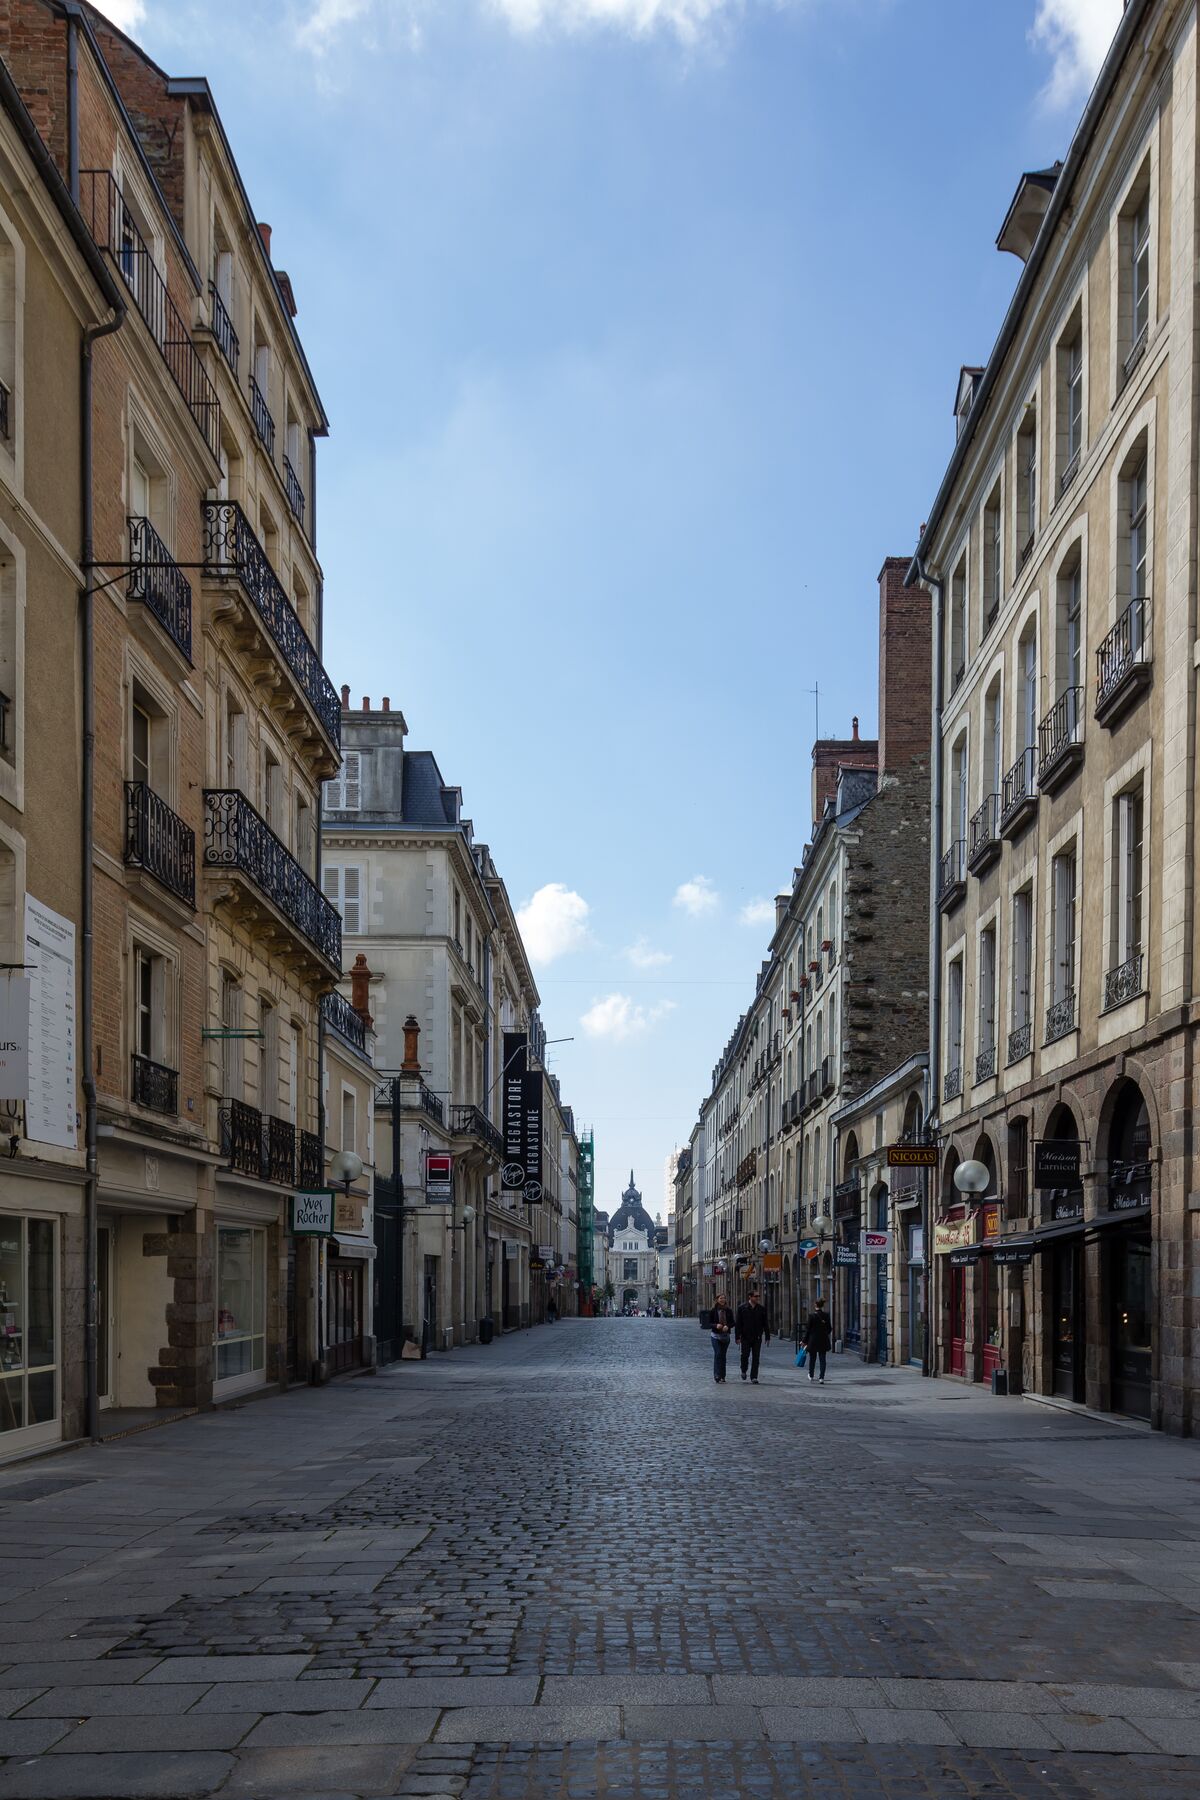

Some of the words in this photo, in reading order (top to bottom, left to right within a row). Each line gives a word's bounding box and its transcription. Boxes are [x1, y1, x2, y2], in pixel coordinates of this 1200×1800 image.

[507, 1078, 522, 1154] MEGASTORE
[526, 1109, 539, 1174] MEGASTORE
[892, 1152, 934, 1161] NICOLAS
[1041, 1151, 1077, 1161] Maison
[1038, 1161, 1076, 1171] Larnicol
[503, 1165, 523, 1184] Virgin
[523, 1182, 542, 1200] Virgin
[303, 1197, 323, 1212] Yves
[296, 1209, 329, 1224] Rocher
[866, 1237, 886, 1245] SNCF
